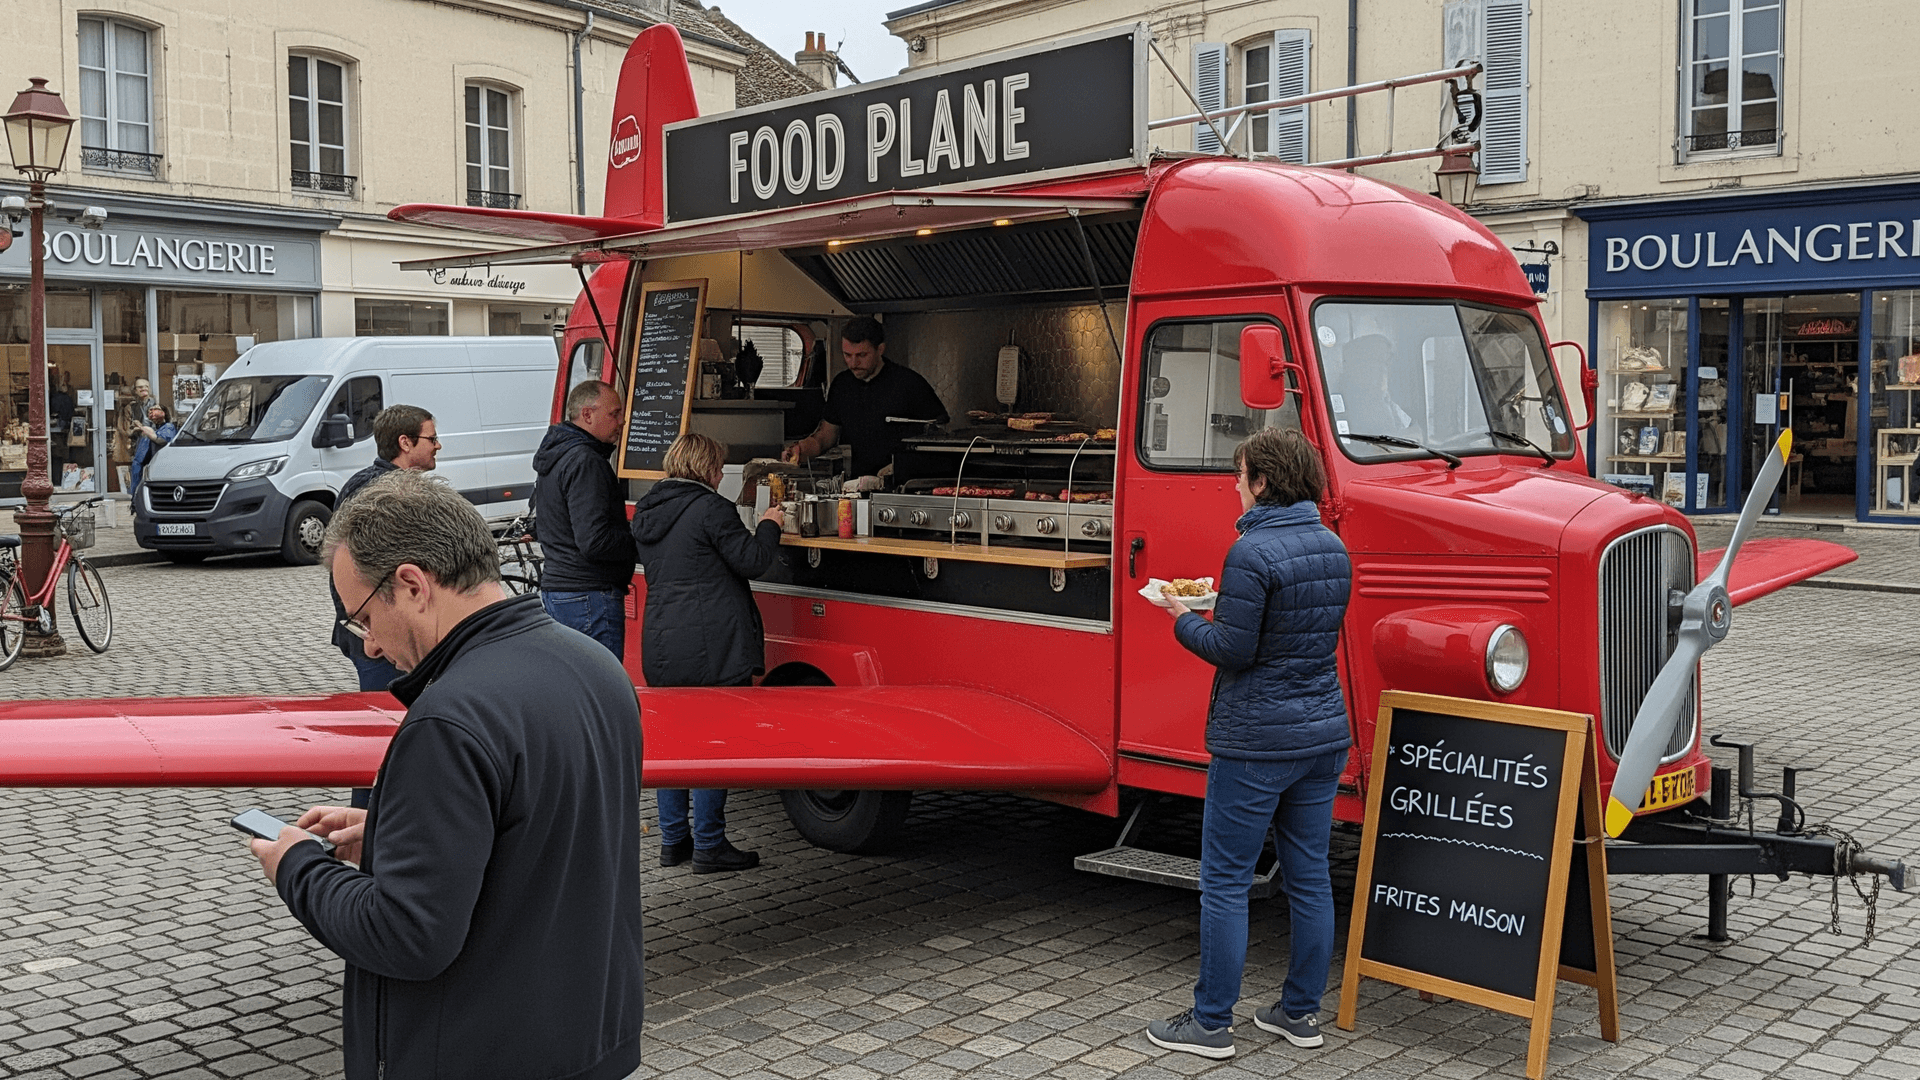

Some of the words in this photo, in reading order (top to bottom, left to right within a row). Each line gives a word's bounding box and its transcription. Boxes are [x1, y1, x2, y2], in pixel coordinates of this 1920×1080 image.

[730, 113, 846, 203] FOOD
[867, 72, 1030, 183] PLANE
[1606, 219, 1920, 272] BOULANGERI
[1400, 739, 1548, 789] SPÉCIALITÉS
[1390, 786, 1514, 829] GRILLÉES
[1374, 884, 1441, 916] FRITES
[1449, 899, 1526, 936] MAISON
